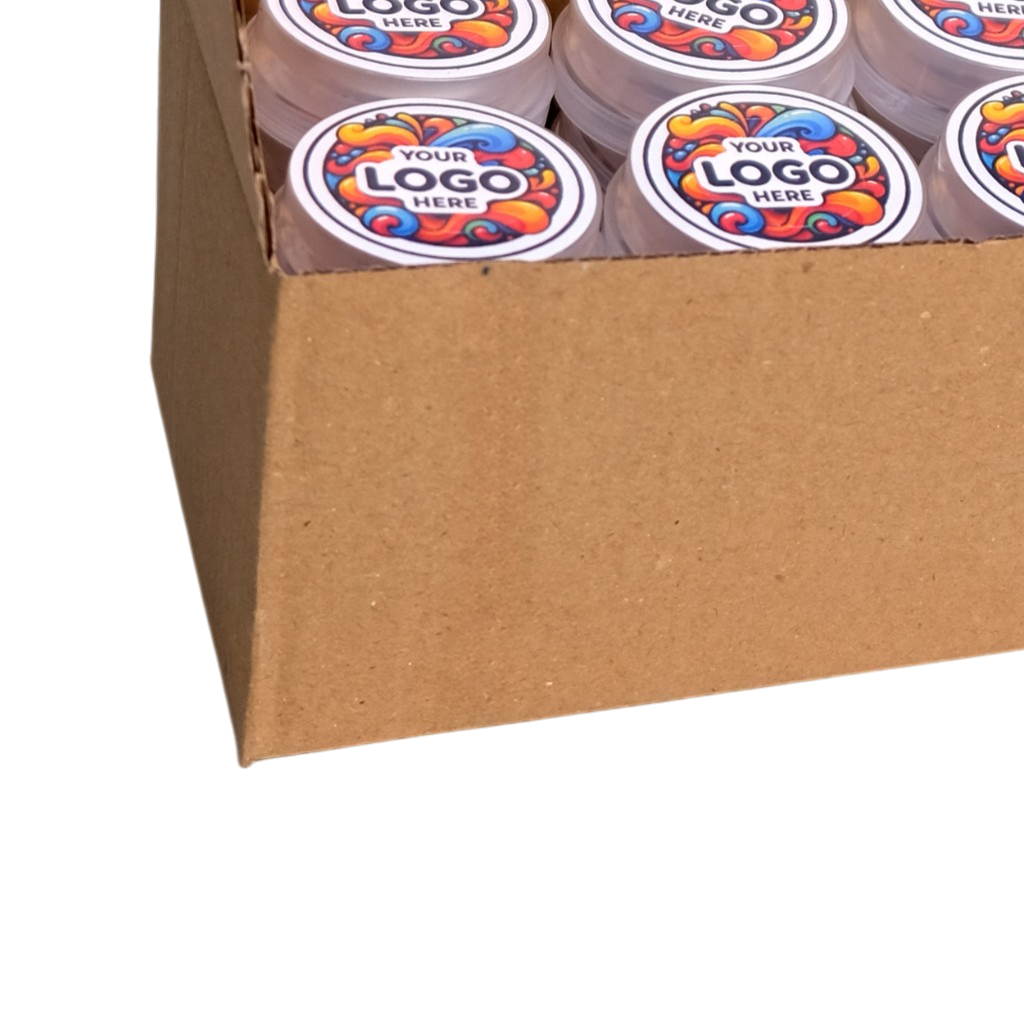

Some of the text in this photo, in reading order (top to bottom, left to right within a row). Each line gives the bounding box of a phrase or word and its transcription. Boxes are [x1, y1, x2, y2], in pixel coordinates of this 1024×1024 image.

[382, 16, 442, 28] HERE
[669, 5, 725, 29] HERE
[730, 141, 795, 153] YOUR
[401, 150, 468, 163] YOUR
[701, 159, 849, 187] LOGO
[365, 167, 521, 194] LOGO
[753, 189, 814, 202] HERE
[412, 196, 477, 210] HERE
